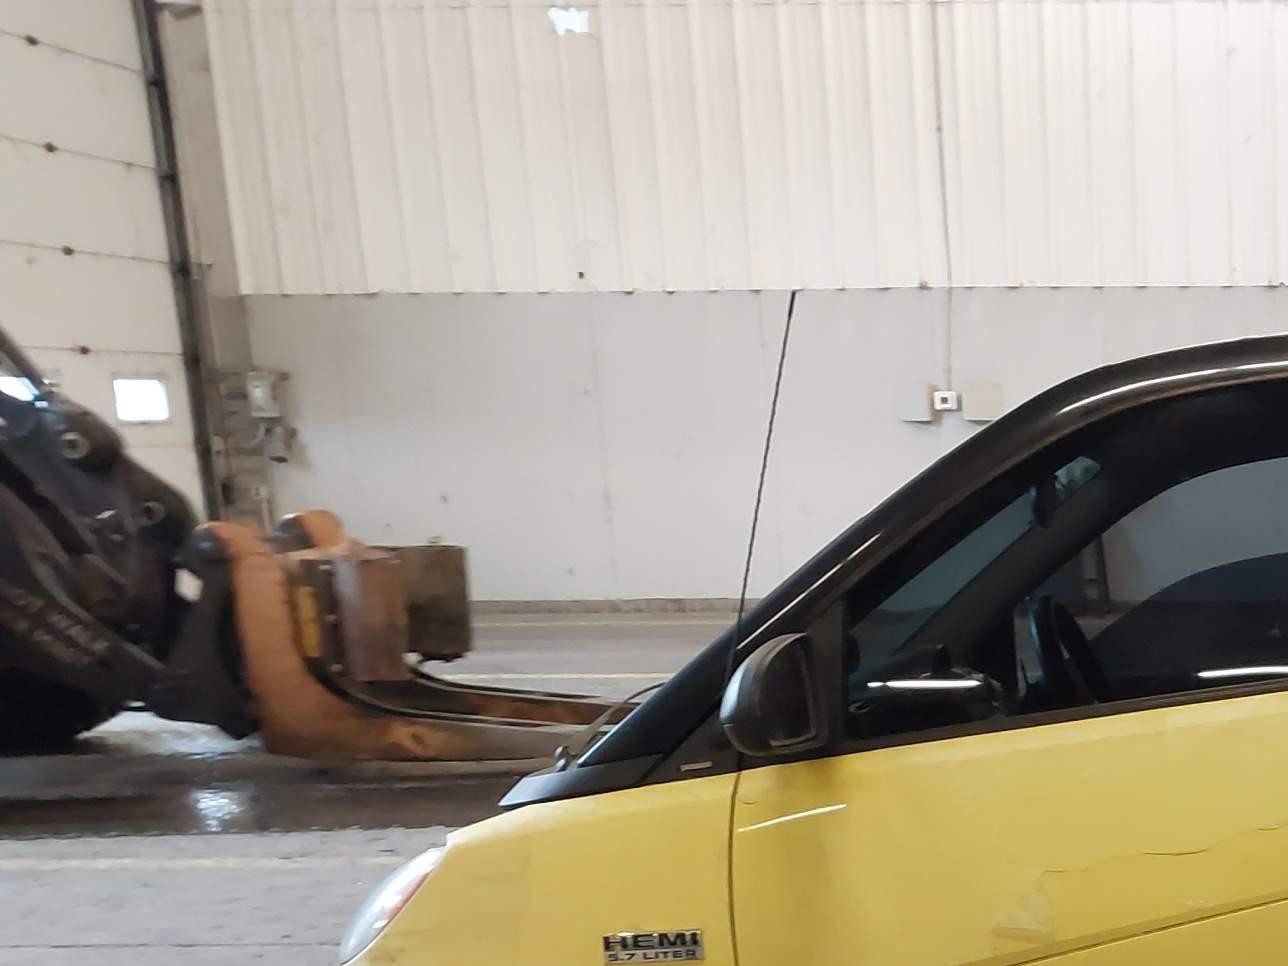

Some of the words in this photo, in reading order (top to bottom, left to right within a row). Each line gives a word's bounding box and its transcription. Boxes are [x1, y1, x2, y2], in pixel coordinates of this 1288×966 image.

[603, 932, 700, 950] HEMI
[607, 952, 637, 962] 5.7
[643, 950, 696, 960] LITER
